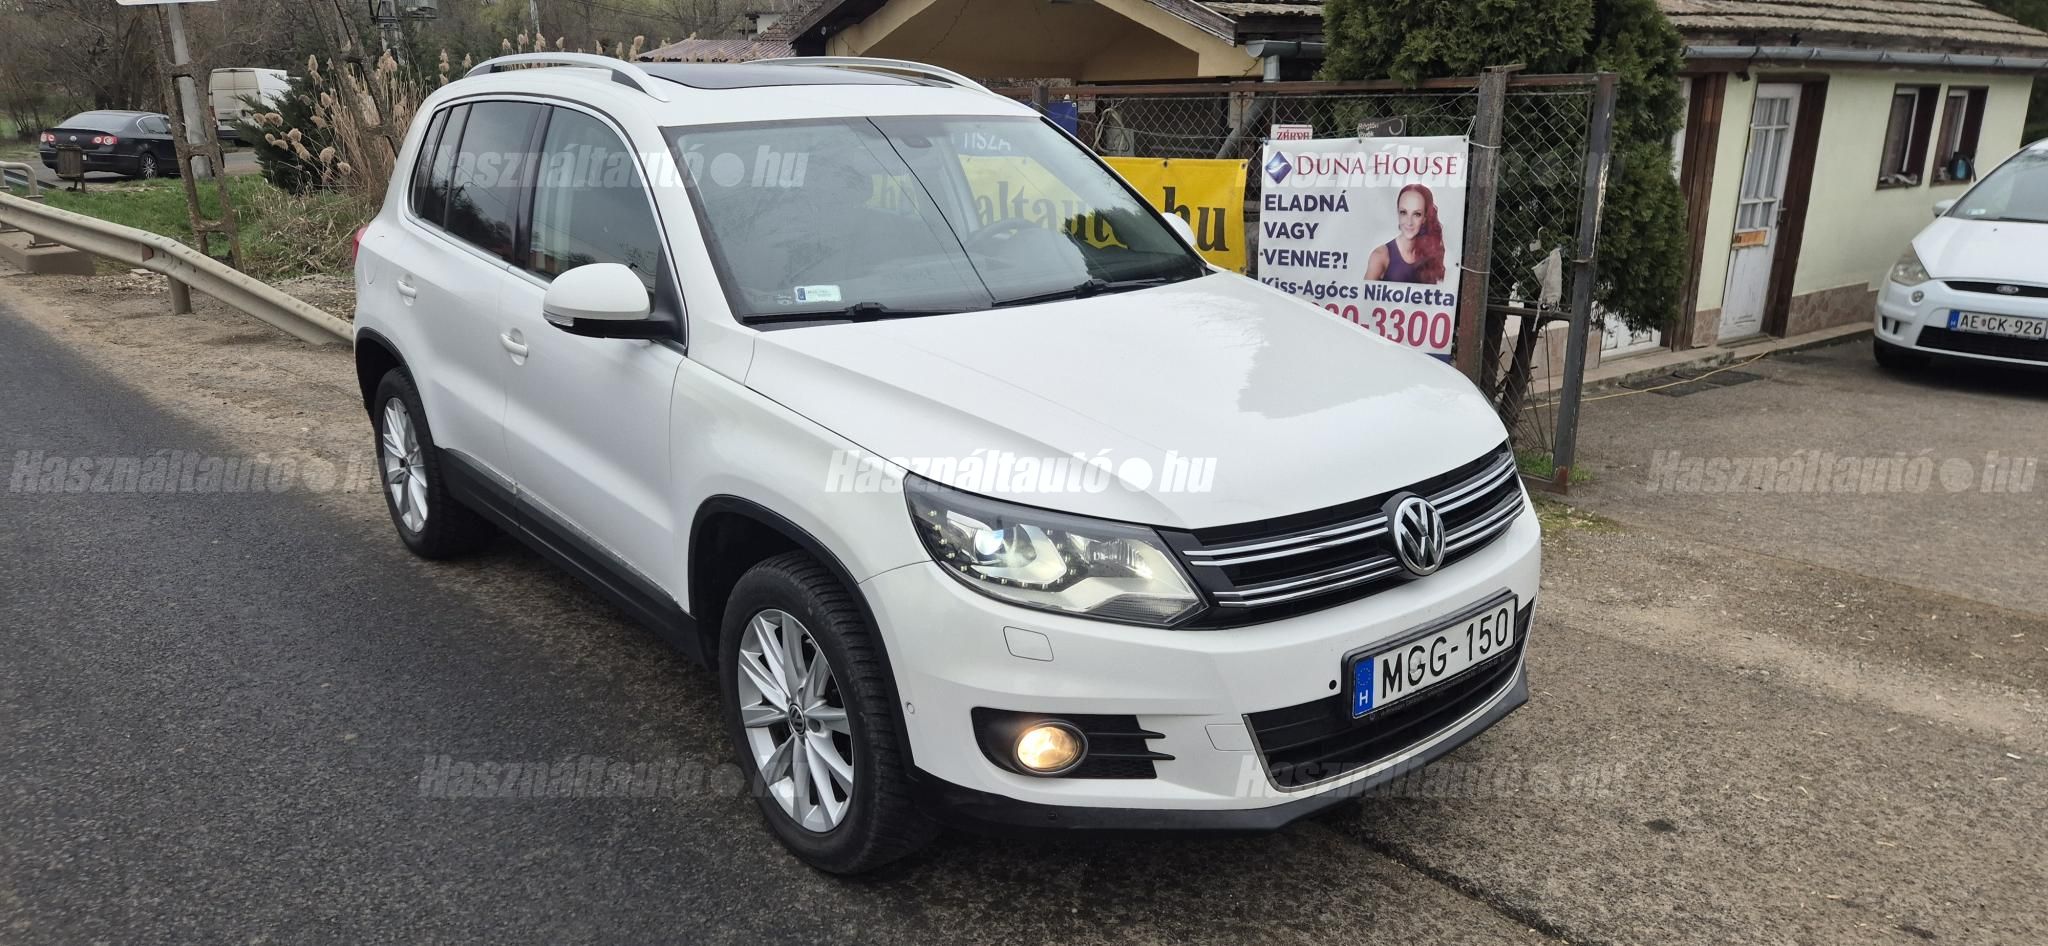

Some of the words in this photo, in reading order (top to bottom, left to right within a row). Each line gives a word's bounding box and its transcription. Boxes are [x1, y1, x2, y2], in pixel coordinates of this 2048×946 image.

[1296, 155, 1365, 176] DUNA
[1374, 154, 1458, 175] HOUSE
[1265, 190, 1349, 212] ELADNÁ
[1264, 222, 1319, 240] VAGY
[1263, 249, 1348, 269] VENNE?!
[1364, 284, 1455, 307] Nikoletta
[1961, 314, 1979, 329] AE
[1987, 317, 2044, 336] CK-926
[1382, 607, 1509, 699] MGG-150
[1359, 690, 1369, 707] H
